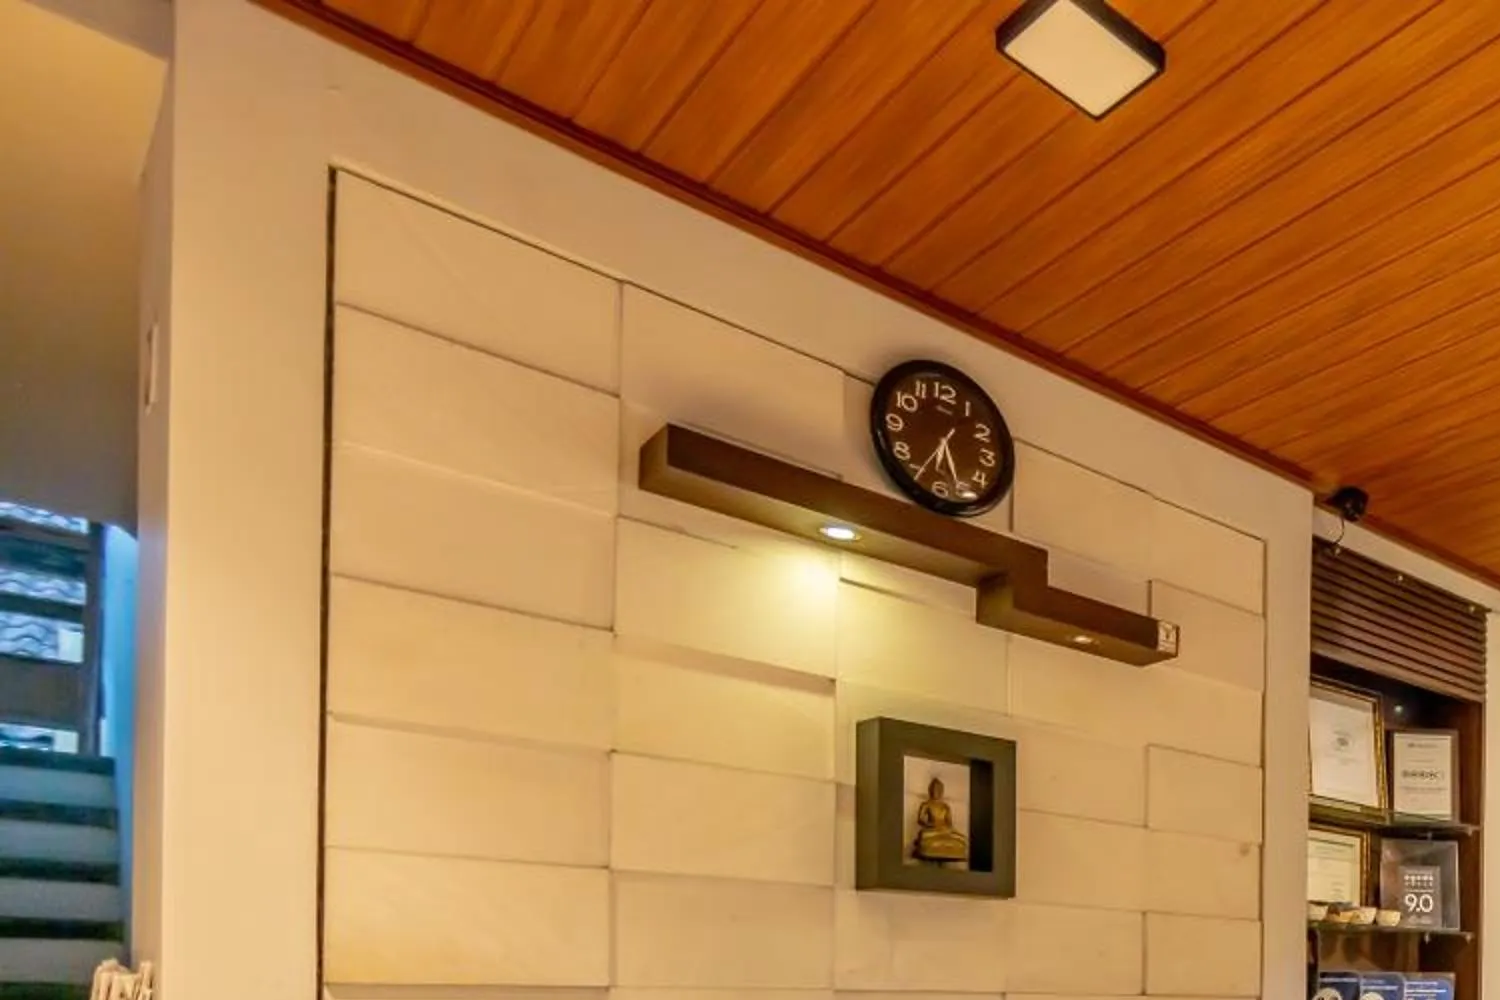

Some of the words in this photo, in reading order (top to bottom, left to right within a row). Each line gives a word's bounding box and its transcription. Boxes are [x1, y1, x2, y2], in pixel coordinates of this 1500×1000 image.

[915, 380, 926, 399] 11
[934, 382, 957, 404] 12
[896, 391, 918, 412] 10
[965, 401, 971, 417] 1
[886, 413, 903, 431] 9
[974, 423, 990, 443] 2
[893, 441, 911, 460] 8
[979, 449, 995, 467] 3
[972, 470, 988, 488] 4
[932, 480, 949, 498] 6
[1404, 893, 1433, 913] 9.0
